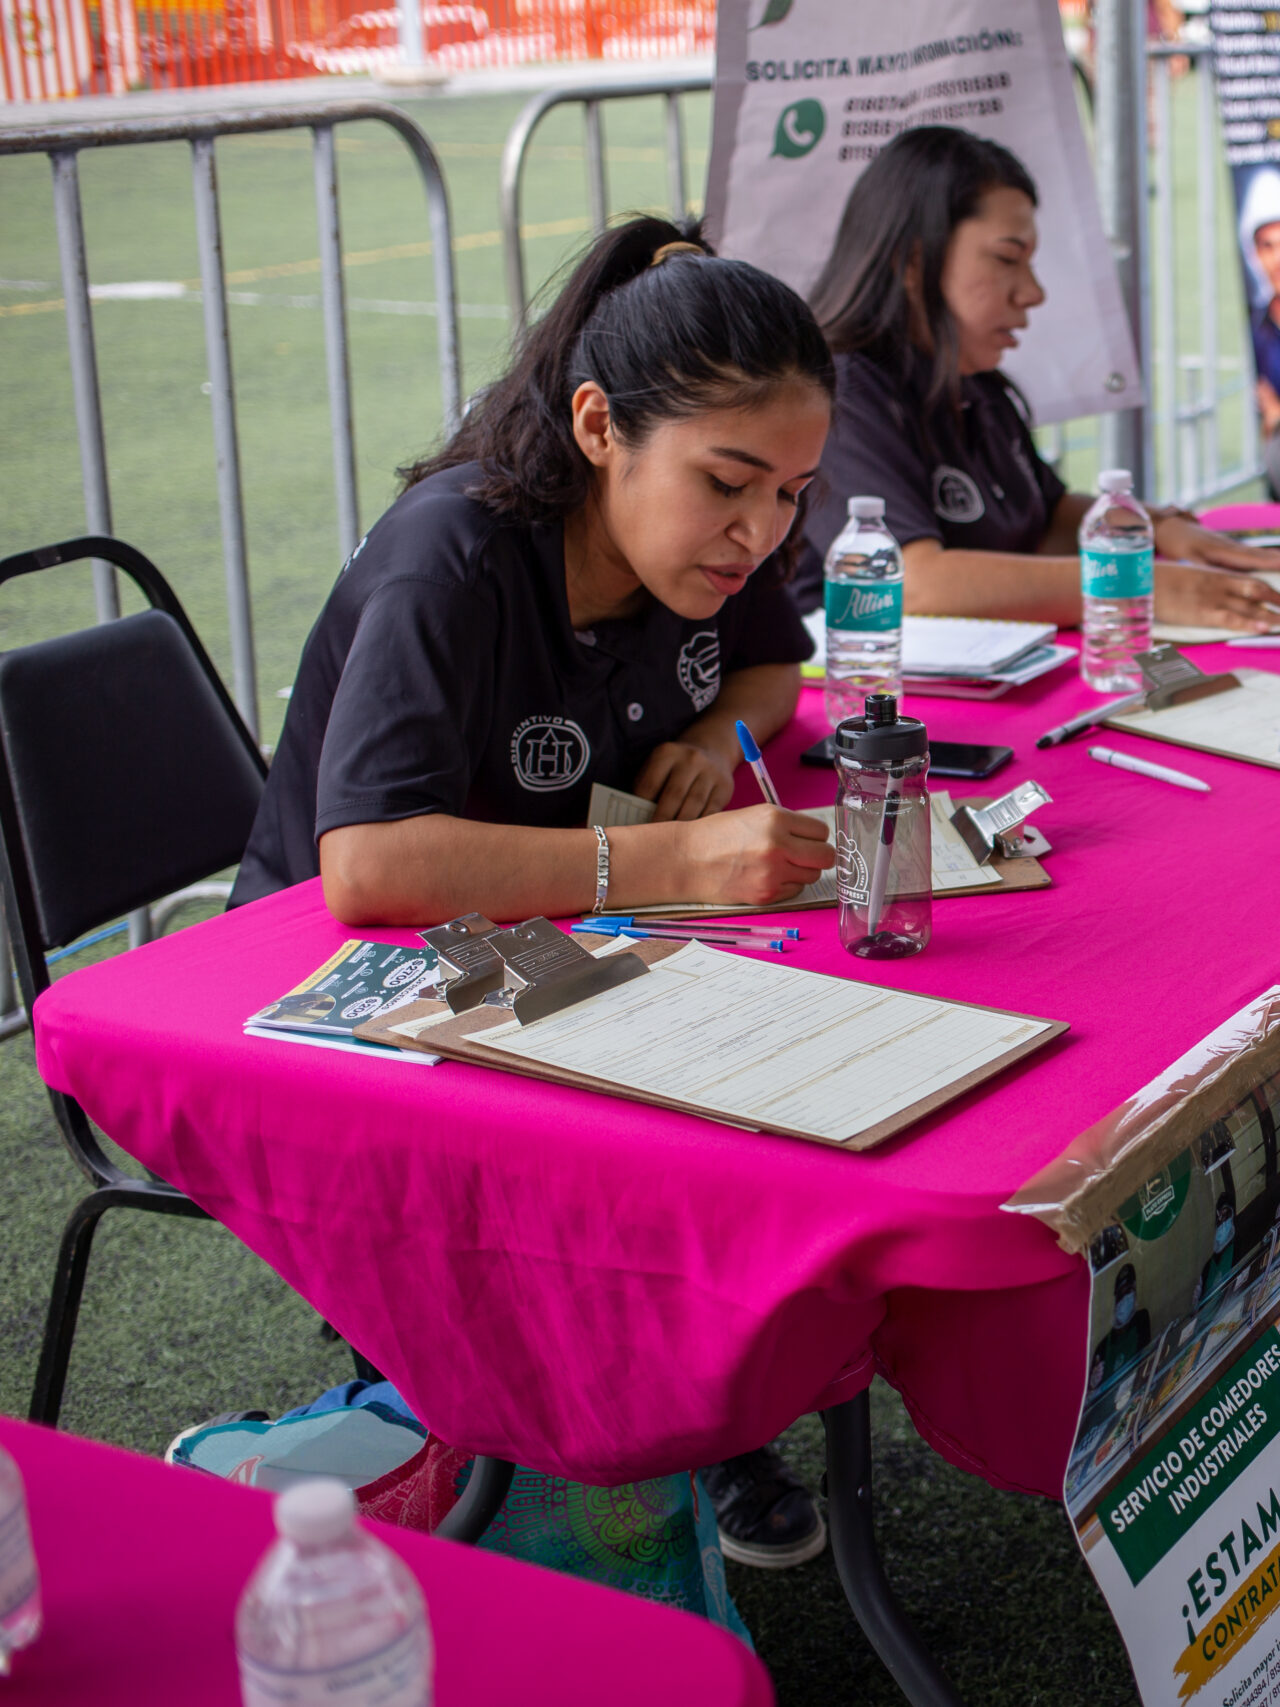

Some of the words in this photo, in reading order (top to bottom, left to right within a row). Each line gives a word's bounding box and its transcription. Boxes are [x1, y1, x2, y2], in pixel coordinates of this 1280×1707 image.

[746, 57, 850, 81] SOLICITA
[510, 715, 563, 764] DISTINTIVO
[389, 960, 424, 986] $2700
[346, 998, 378, 1019] $200
[381, 977, 426, 1011] OFRECEMOS
[1167, 1402, 1268, 1515] INDUSTRIALES
[1110, 1451, 1183, 1533] SERVICIO
[1178, 1427, 1206, 1461] DE
[1222, 1675, 1252, 1707] Solicita
[1252, 1647, 1276, 1680] mayor
